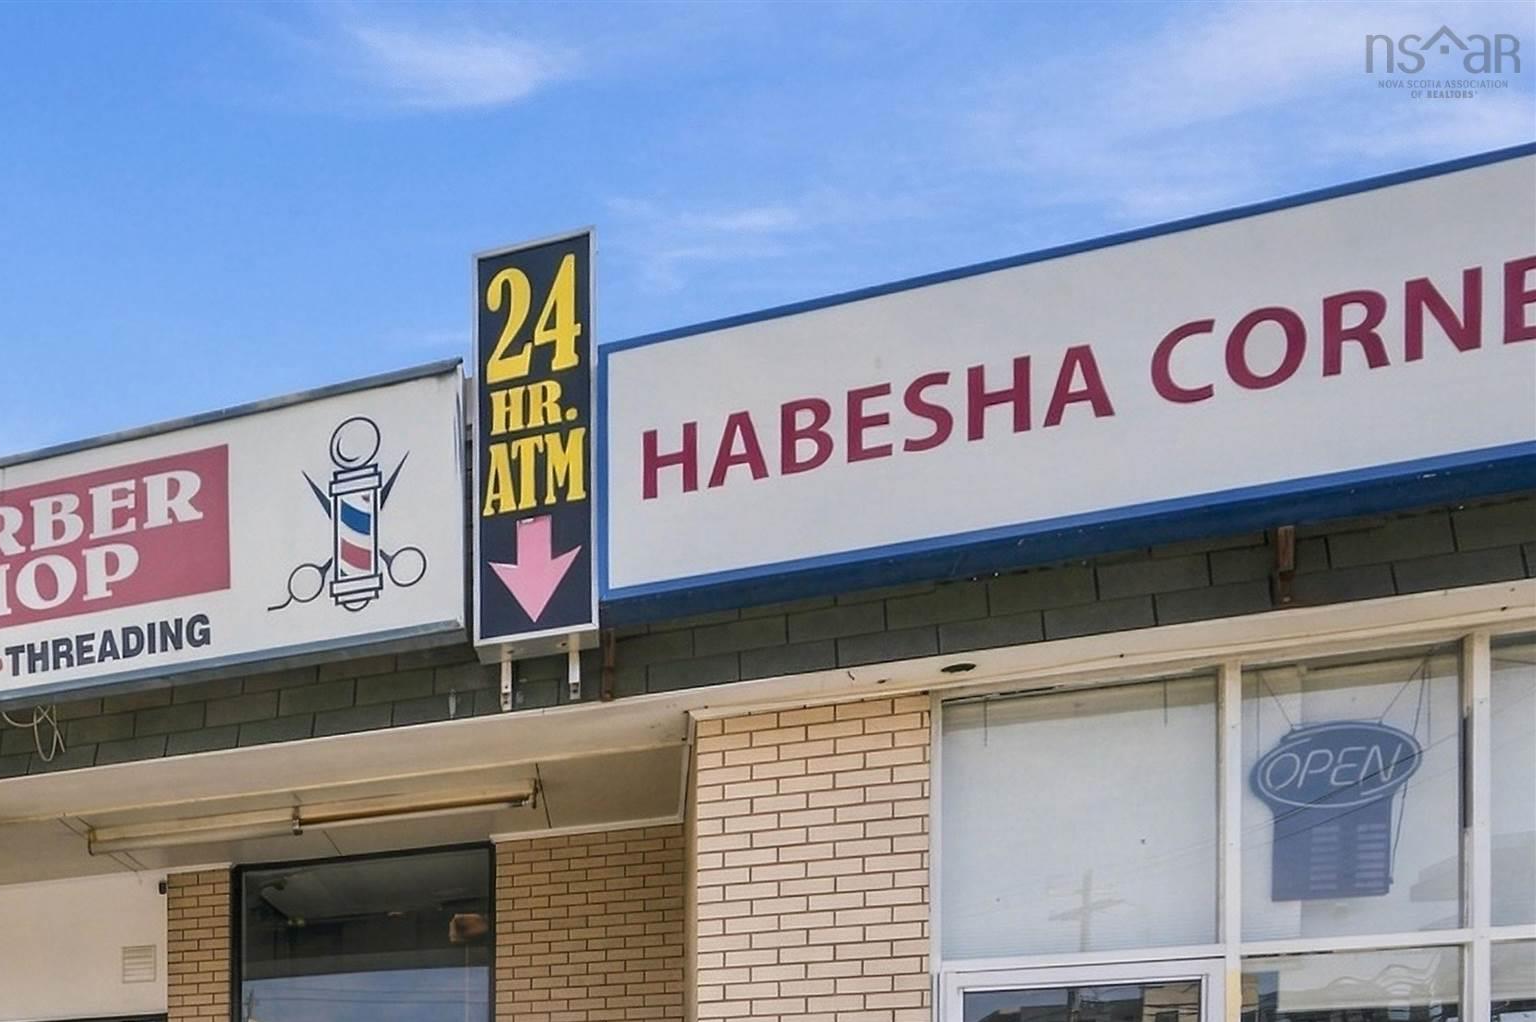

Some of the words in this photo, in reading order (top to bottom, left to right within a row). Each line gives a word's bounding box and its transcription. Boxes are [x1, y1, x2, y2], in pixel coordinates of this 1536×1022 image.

[486, 252, 582, 385] 24
[490, 379, 578, 437] HR.
[642, 343, 1115, 501] HABESHA
[482, 426, 587, 517] ATM
[4, 613, 212, 678] THREADING
[1265, 743, 1403, 792] OPEN
